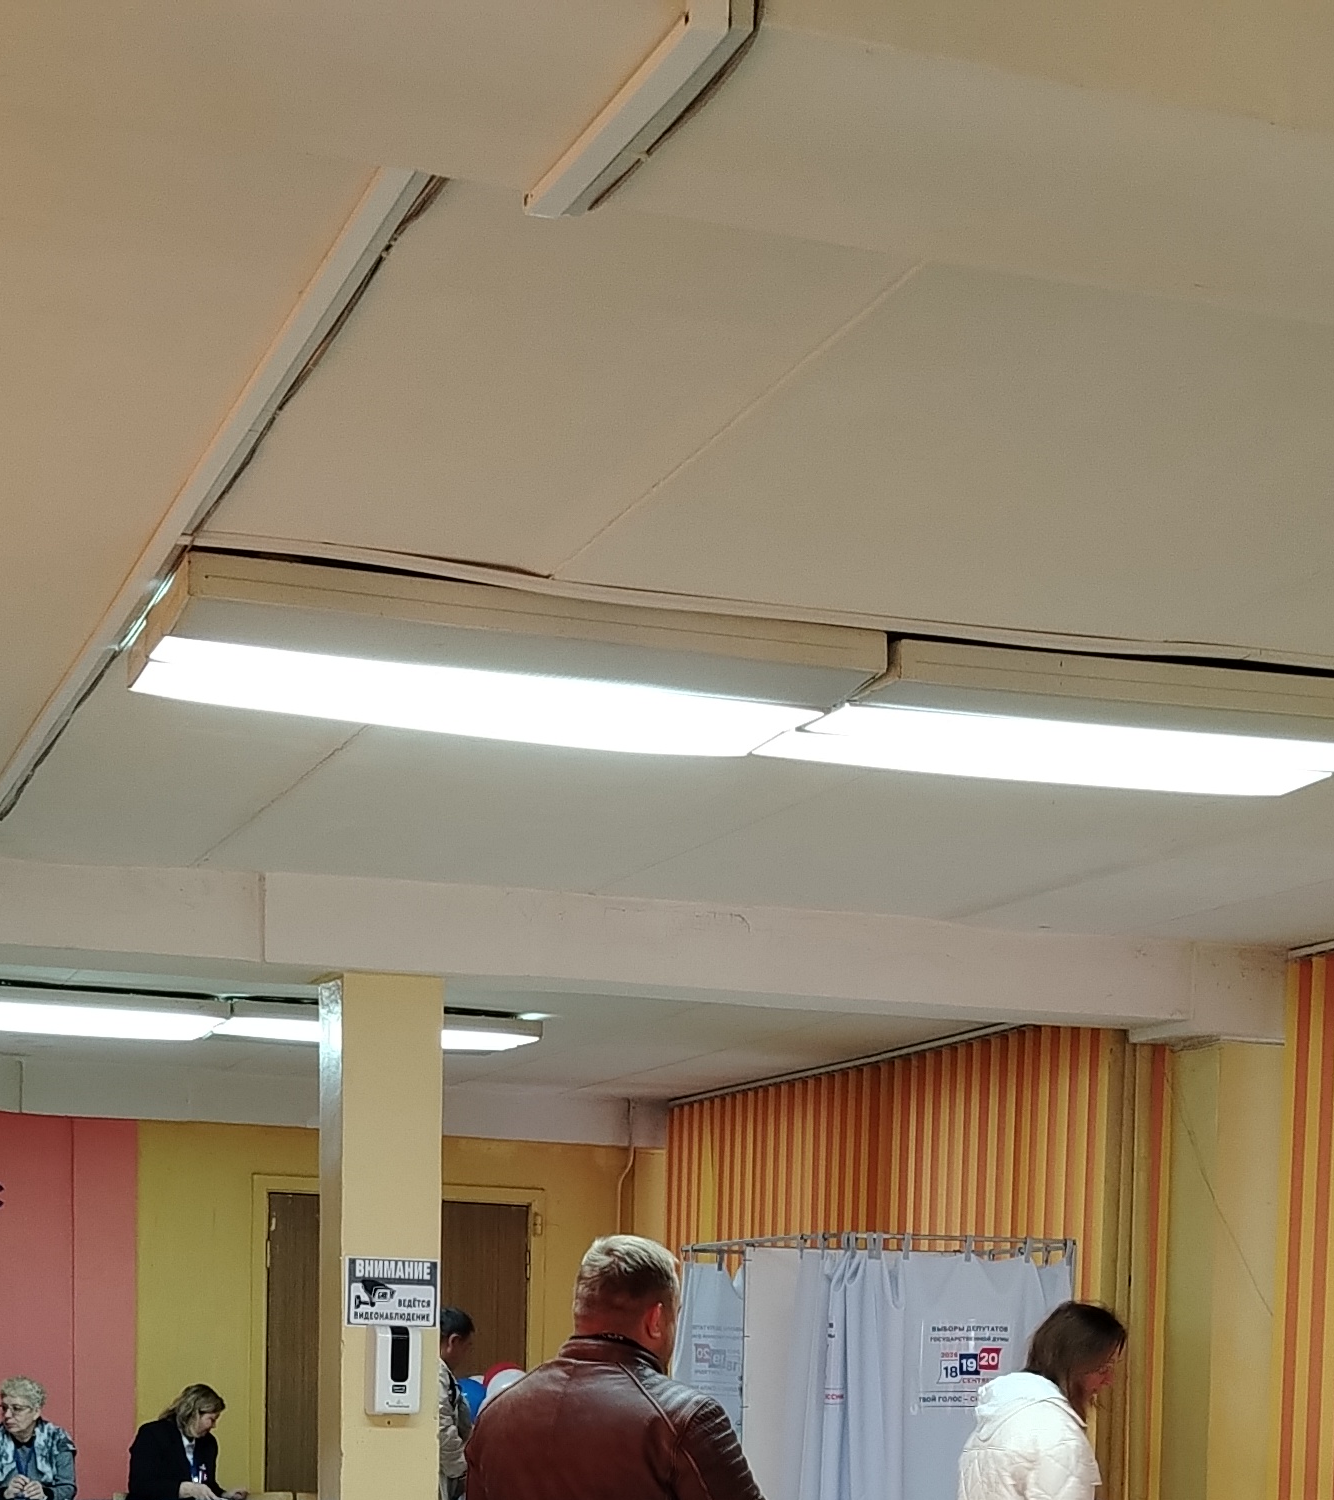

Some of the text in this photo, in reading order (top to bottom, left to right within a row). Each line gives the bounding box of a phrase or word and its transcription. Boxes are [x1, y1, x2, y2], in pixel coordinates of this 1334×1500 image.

[355, 1259, 431, 1280] ВНИМАНИЕ
[398, 1298, 430, 1308] ВЕДЁТСЯ
[354, 1311, 430, 1322] ВИДЕОНАБЛЮДЕНИЕ
[943, 1353, 997, 1378] 18 19 20
